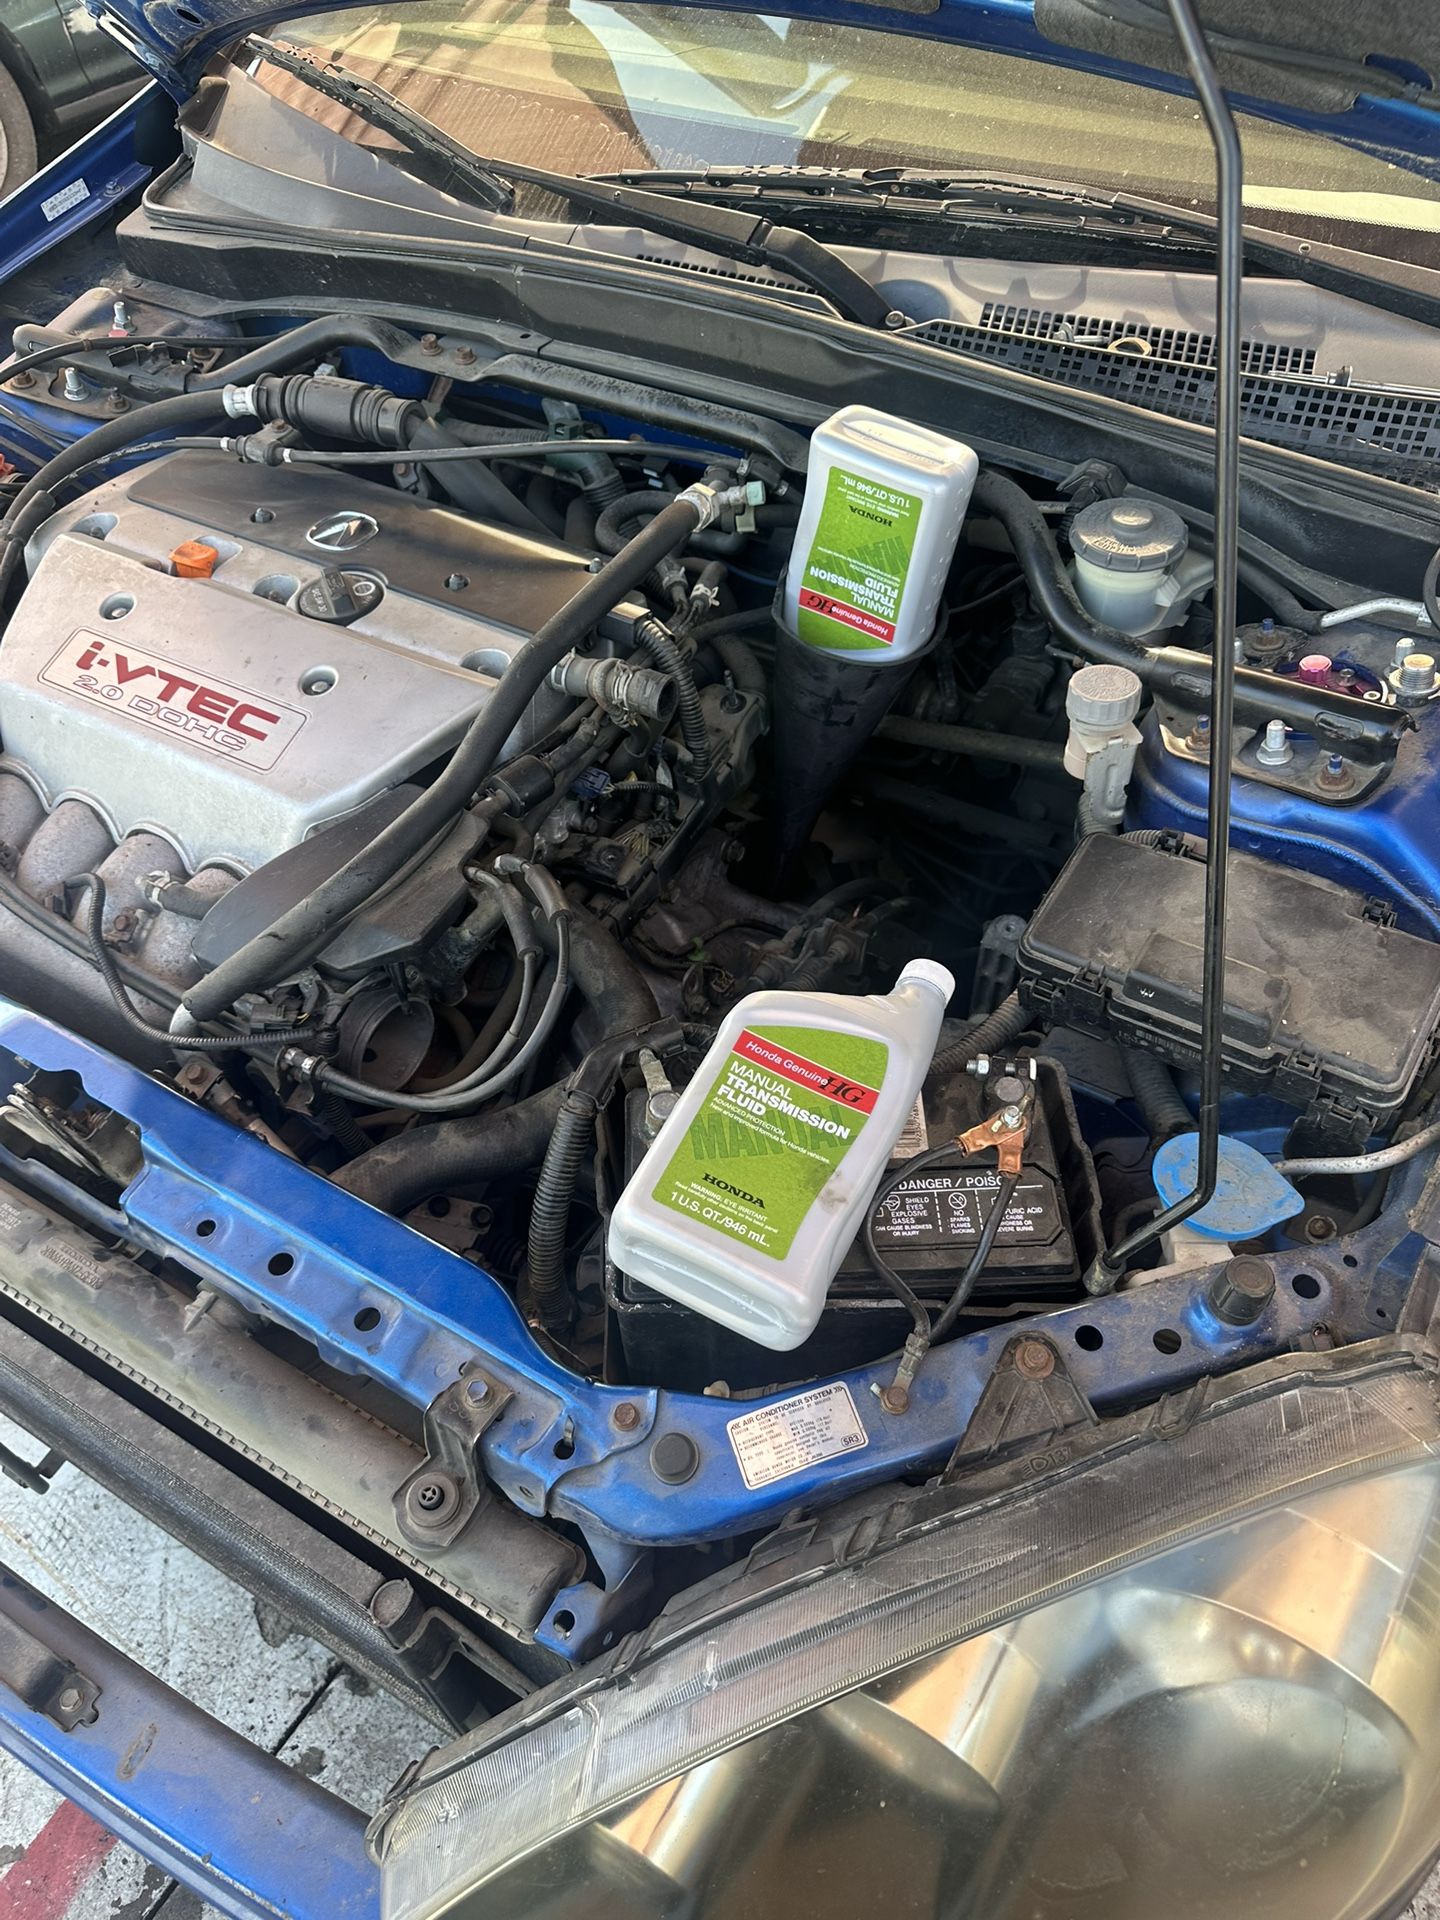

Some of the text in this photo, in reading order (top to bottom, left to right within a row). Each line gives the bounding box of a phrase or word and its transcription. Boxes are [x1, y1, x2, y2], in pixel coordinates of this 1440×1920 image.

[888, 493, 905, 507] U.S.
[904, 499, 911, 508] 1
[849, 505, 893, 527] HONDA
[809, 566, 896, 609] TRANSMISSION
[864, 577, 899, 599] FLUID
[807, 595, 889, 635] Honda Genuine HG
[850, 591, 895, 619] MANUAL
[76, 641, 281, 741] i-VTEC
[73, 675, 248, 751] 2.0 DOHC
[730, 1061, 793, 1101] MANUAL
[746, 1041, 866, 1104] Honda Genuine HG
[717, 1085, 767, 1116] FLUID
[727, 1074, 851, 1140] TRANSMISSION
[710, 1102, 722, 1112] New
[722, 1109, 733, 1119] and
[734, 1113, 759, 1132] improved
[758, 1127, 780, 1142] formula
[779, 1136, 788, 1145] for
[788, 1140, 807, 1155] Honda
[713, 1096, 785, 1137] ADVANCED PROTECTION
[702, 1172, 766, 1209] HONDA
[899, 1176, 1002, 1190] DANGER / POISO
[723, 1198, 738, 1209] EYE
[738, 1206, 768, 1222] IRRITANT
[890, 1210, 928, 1218] EXPLOSIVE
[905, 1196, 930, 1204] SHIELD
[906, 1203, 925, 1211] EYES
[1026, 1206, 1043, 1214] ACID
[671, 1192, 770, 1248] 1 U.S. QT./946 mL.
[892, 1217, 916, 1225] GASES
[904, 1223, 933, 1231] BLINDNESS
[742, 1417, 754, 1427] AIR
[755, 1398, 804, 1421] CONDITIONER
[804, 1388, 833, 1404] SYSTEM
[843, 1434, 860, 1446] SR3
